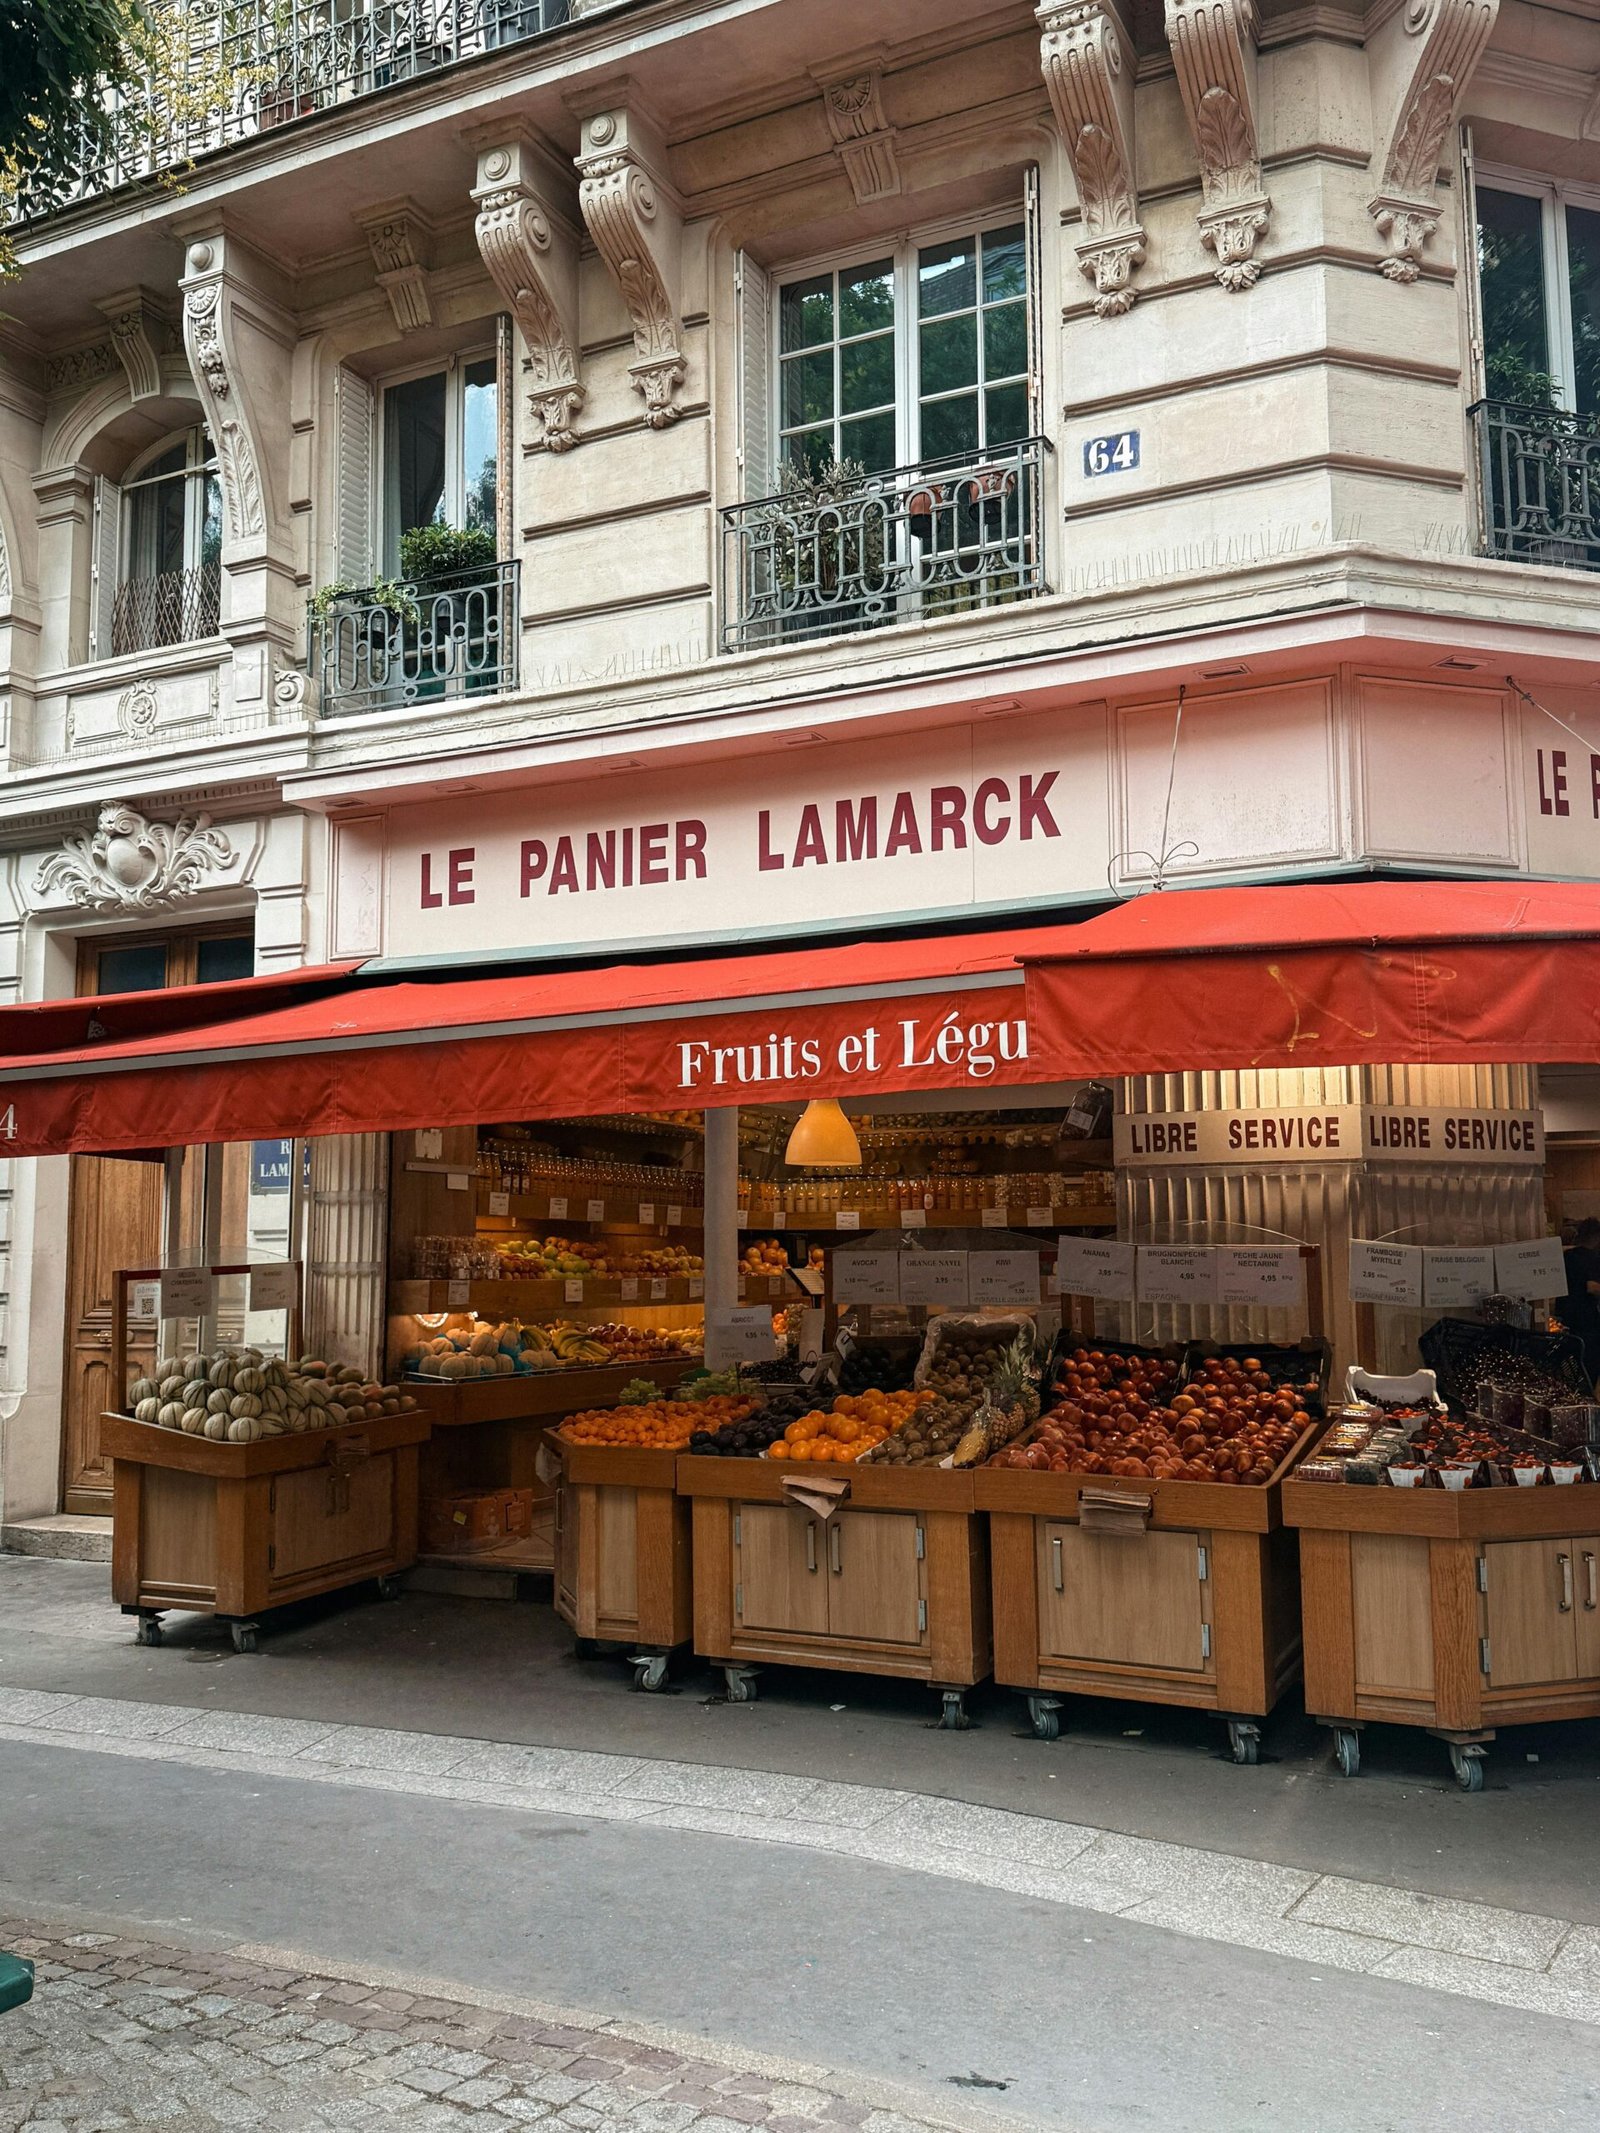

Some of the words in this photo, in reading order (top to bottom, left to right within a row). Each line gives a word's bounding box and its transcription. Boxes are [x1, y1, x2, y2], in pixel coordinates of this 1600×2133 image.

[1088, 434, 1134, 473] 64
[1537, 748, 1570, 817] LE
[421, 847, 475, 909] LE
[520, 819, 708, 898] PANIER
[758, 770, 1062, 871] LAMARCK
[676, 1033, 821, 1088] Fruits
[838, 1026, 880, 1073] et
[1131, 1121, 1198, 1153] LIBRE
[1228, 1116, 1340, 1149] SERVICE
[1369, 1115, 1431, 1148] LIBRE
[1444, 1118, 1536, 1152] SERVICE
[1082, 1248, 1111, 1258] ANANAS
[1161, 1258, 1195, 1266] BLANCHE
[1237, 1260, 1280, 1268] NECTARINE
[1259, 1252, 1284, 1260] JAUNE
[1179, 1272, 1195, 1280] 4,95
[1260, 1274, 1277, 1282] 4,95
